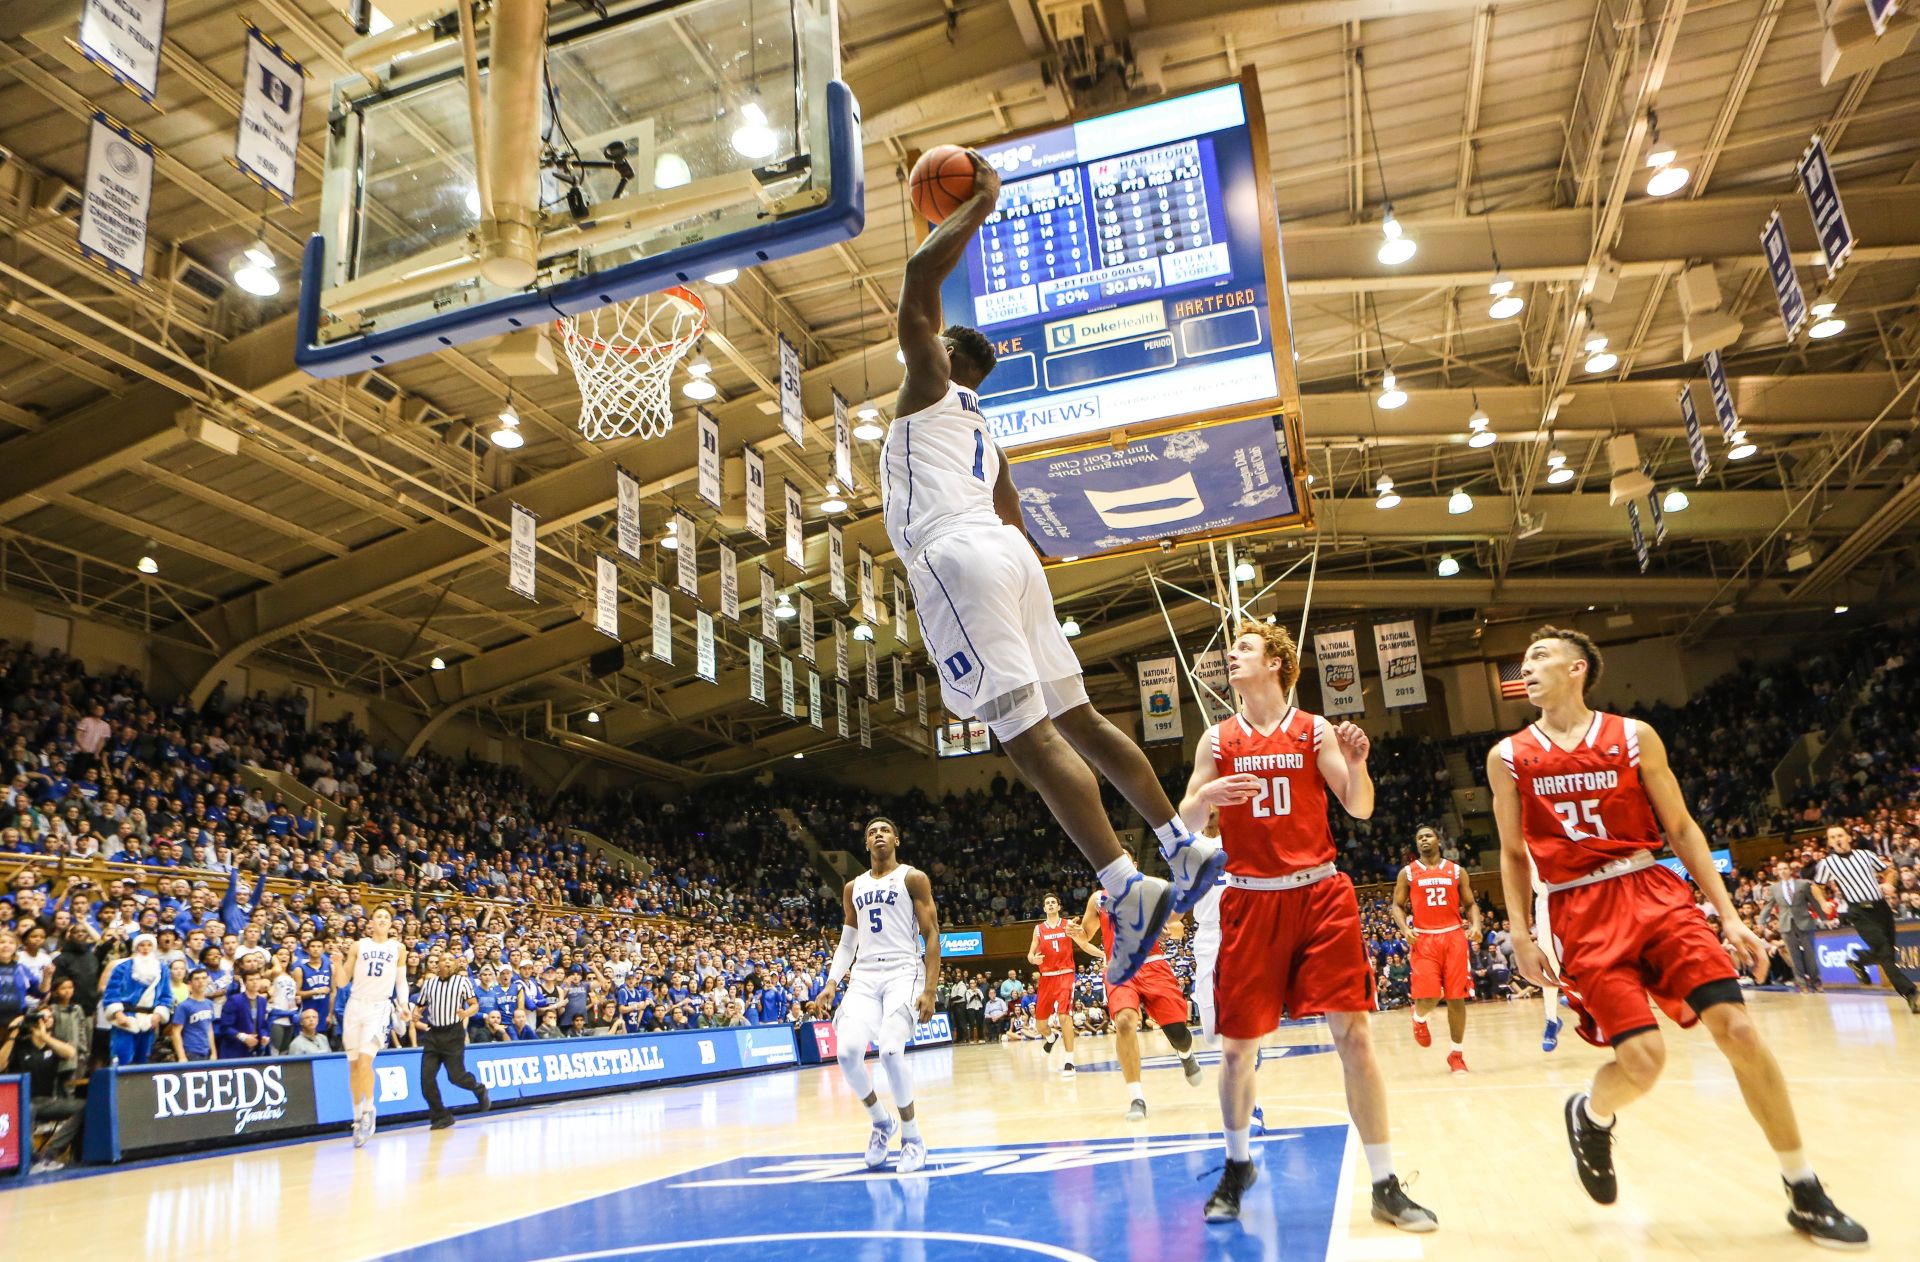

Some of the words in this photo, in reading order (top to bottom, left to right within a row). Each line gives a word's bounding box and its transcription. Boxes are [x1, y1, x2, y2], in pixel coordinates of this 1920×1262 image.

[244, 116, 272, 142] FINAL
[1120, 145, 1193, 170] HARTFORD
[98, 174, 139, 205] ATLANTIC
[1098, 183, 1117, 198] NO
[1121, 176, 1146, 193] PTS
[103, 189, 132, 212] COAST
[1132, 205, 1142, 218] 0
[1159, 199, 1169, 212] 0
[1186, 193, 1196, 206] 0
[985, 211, 1002, 225] NO
[1006, 204, 1030, 220] PTS
[1188, 206, 1198, 220] 0
[89, 205, 144, 241] CHAMPIONS
[1190, 220, 1200, 234] 0
[1138, 246, 1148, 259] 0
[1166, 240, 1176, 254] 0
[1192, 234, 1202, 248] 0
[1020, 260, 1029, 272] 0
[1046, 253, 1055, 266] 0
[1072, 247, 1081, 260] 0
[1173, 251, 1216, 267] DUKE
[1021, 272, 1031, 285] 0
[1054, 281, 1076, 291] 3-PT
[1080, 273, 1108, 286] FIELD
[1112, 264, 1145, 278] GOALS
[1176, 264, 1219, 280] STORES
[986, 292, 1025, 307] DUKE
[1056, 290, 1089, 306] 20%
[1175, 288, 1255, 318] HARTFORD
[987, 306, 1029, 320] STORES
[1081, 311, 1159, 338] DukeHealth
[1144, 338, 1172, 351] PERIOD
[1031, 401, 1096, 427] NEWS
[972, 428, 985, 482] 1
[1128, 444, 1150, 455] Inn
[1049, 460, 1080, 472] Club
[1083, 454, 1112, 466] Golf
[1084, 452, 1159, 473] Washington
[1048, 468, 1082, 479] Duke
[1381, 631, 1410, 641] NATIONAL
[1321, 642, 1350, 652] NATIONAL
[1378, 640, 1416, 651] CHAMPIONS
[1318, 650, 1355, 661] CHAMPIONS
[1143, 668, 1172, 678] NATIONAL
[1389, 661, 1417, 678] FOUR
[1141, 677, 1176, 687] CHAMPIONS
[1395, 687, 1415, 696] 2015
[1334, 696, 1354, 706] 2010
[1154, 722, 1172, 731] 1991
[1234, 753, 1304, 773] HARTFORD
[1532, 770, 1618, 796] HARTFORD
[1252, 776, 1292, 818] 20
[1554, 798, 1608, 842] 25
[1418, 877, 1453, 887] HARTFORD
[855, 890, 899, 911] DUKE
[1426, 887, 1448, 907] 22
[868, 908, 883, 934] 5
[945, 938, 980, 948] MAKO
[1052, 940, 1060, 952] 4
[362, 950, 394, 962] DUKE
[368, 961, 384, 977] 15
[306, 975, 330, 988] DUKE
[914, 1018, 949, 1041] GEICO
[477, 1056, 542, 1090] DUKE
[543, 1046, 664, 1082] BASKETBALL
[152, 1065, 286, 1119] REEDS
[234, 1107, 286, 1135] Jewelers
